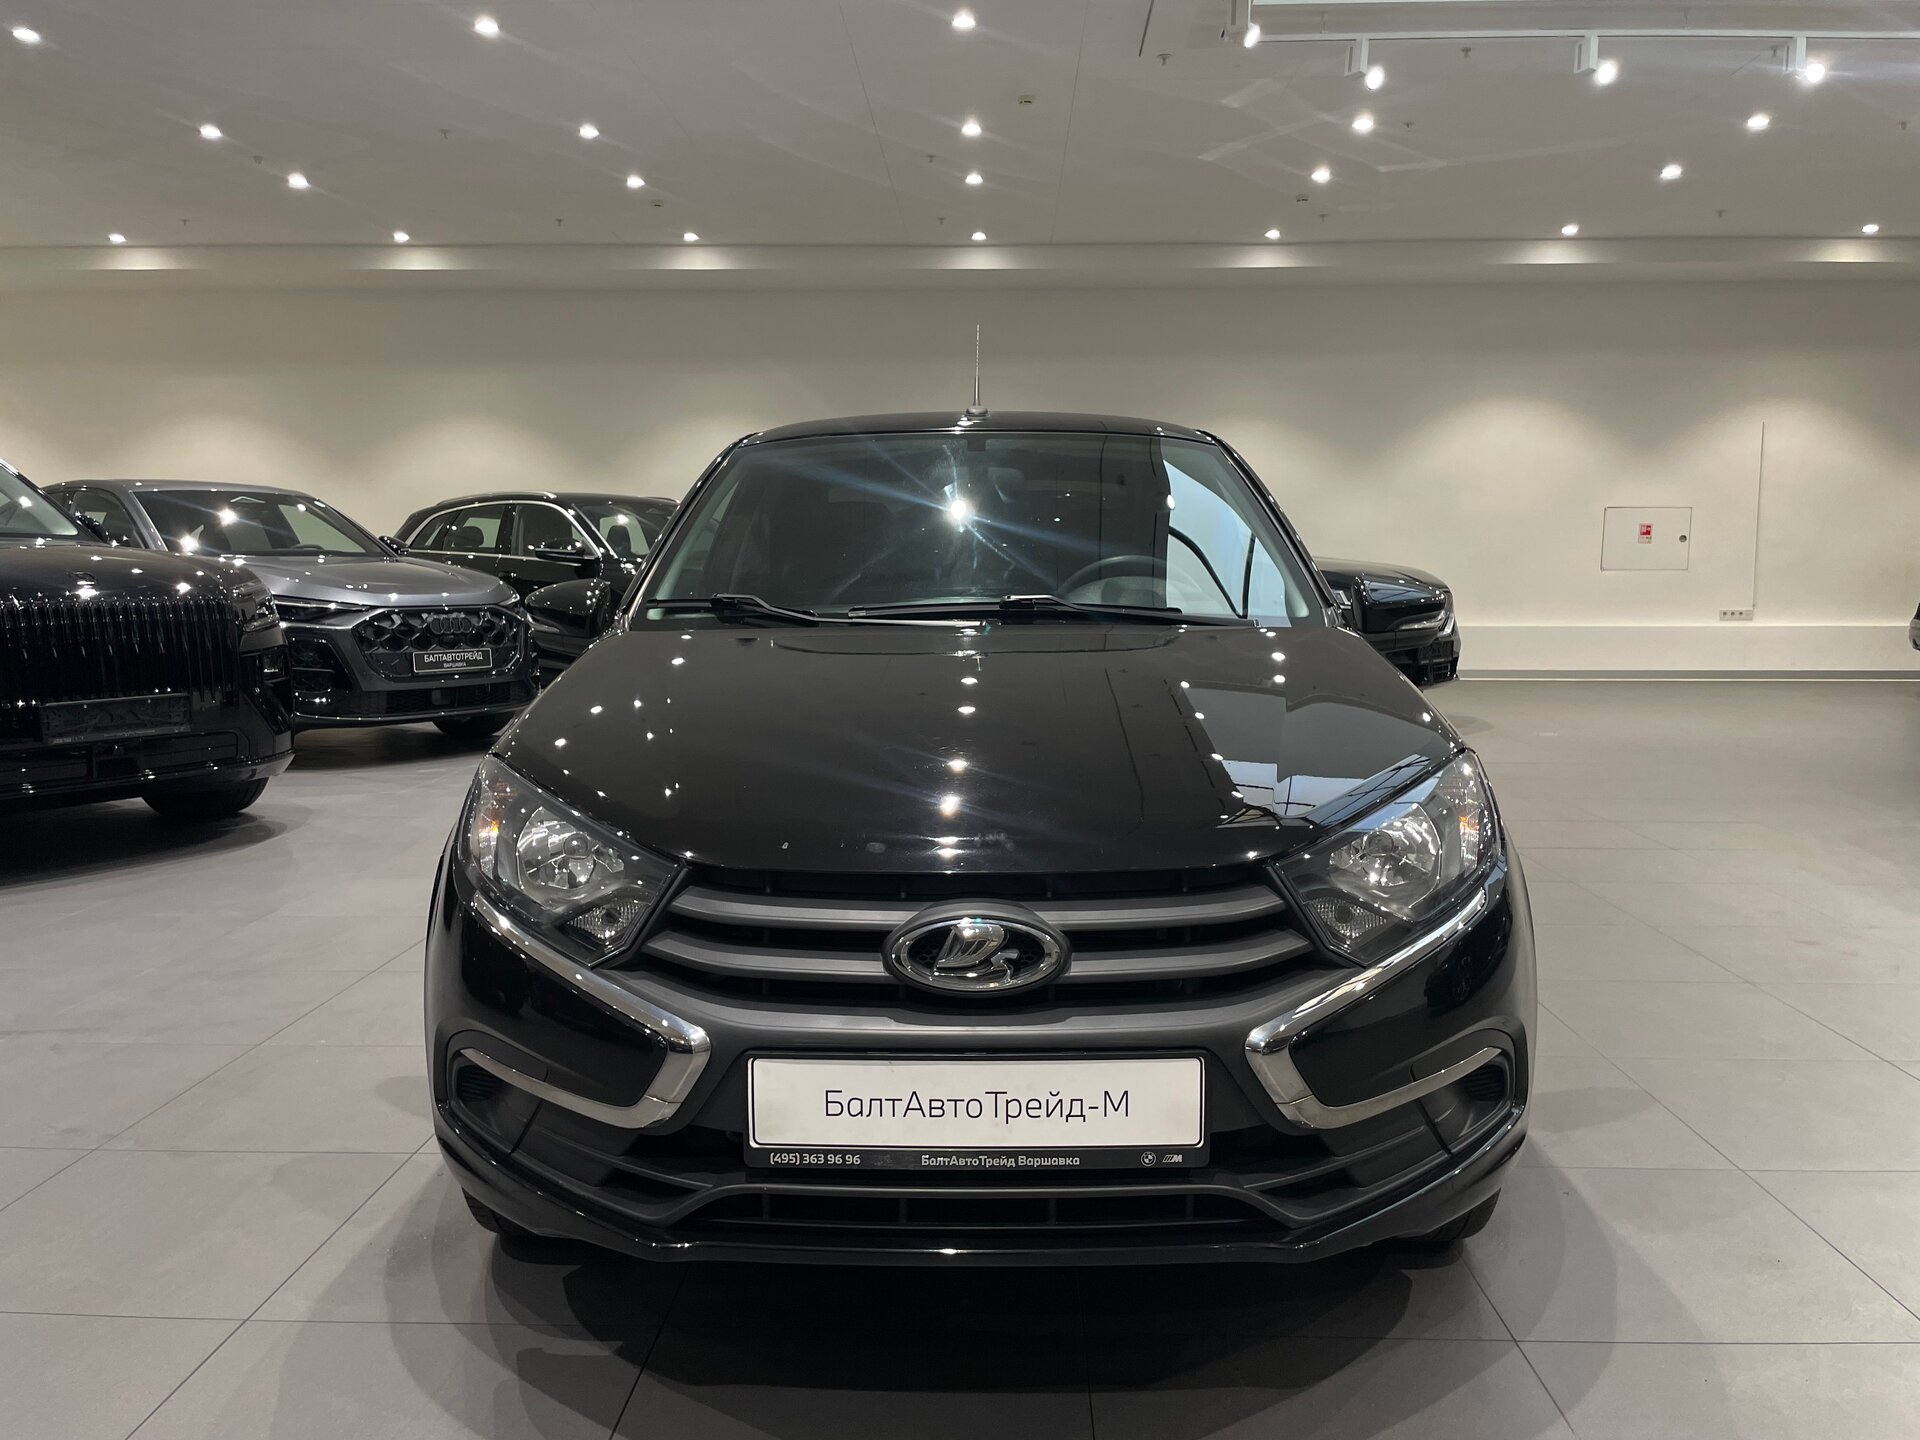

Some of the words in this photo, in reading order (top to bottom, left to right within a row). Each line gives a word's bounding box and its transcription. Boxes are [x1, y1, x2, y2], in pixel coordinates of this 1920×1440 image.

[424, 651, 483, 662] БАЛТАВТОТРЕЙД
[824, 1090, 1129, 1124] БалтАвтоТрейд-М
[770, 1152, 800, 1165] (495)
[802, 1154, 825, 1164] 363
[827, 1154, 843, 1164] 96
[845, 1154, 861, 1164] 96
[921, 1154, 1016, 1168] БалтАвтоТрейд
[1018, 1155, 1080, 1167] Варшавка
